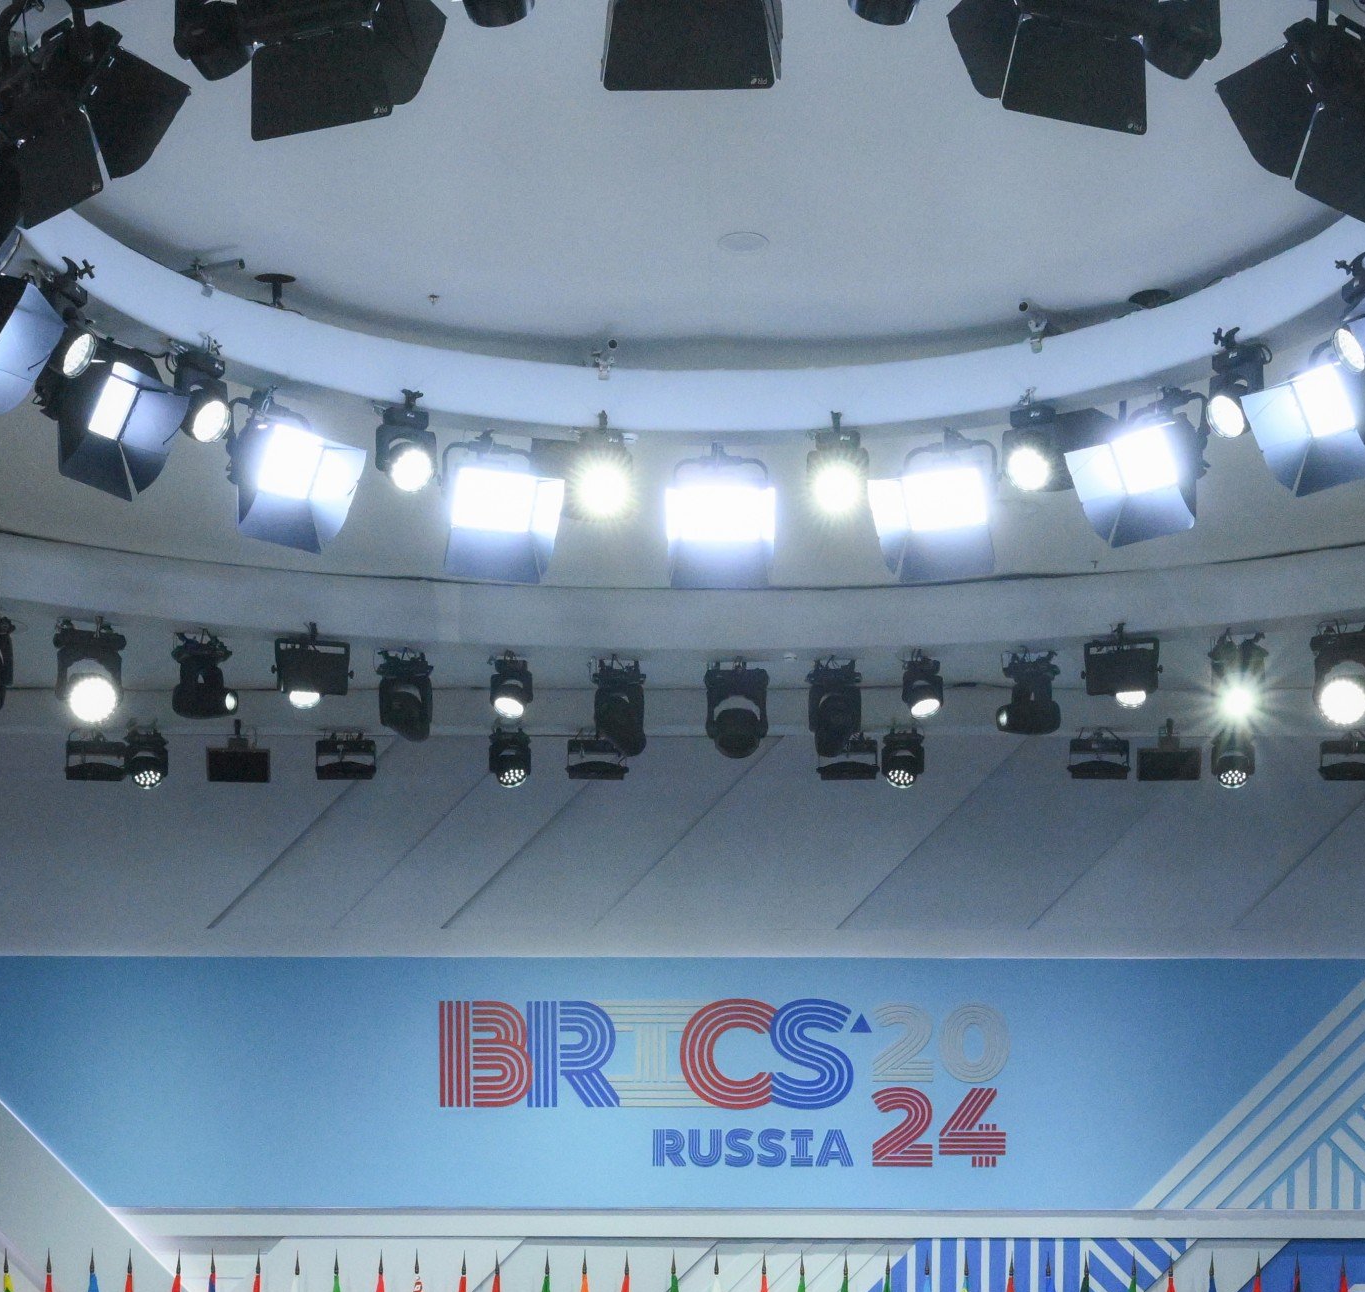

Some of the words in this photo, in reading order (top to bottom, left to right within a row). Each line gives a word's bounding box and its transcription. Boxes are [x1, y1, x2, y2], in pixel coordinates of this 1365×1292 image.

[438, 998, 855, 1110] BRICS
[872, 1001, 1011, 1084] 20
[652, 1128, 855, 1168] RUSSIA
[872, 1087, 1007, 1168] 24
